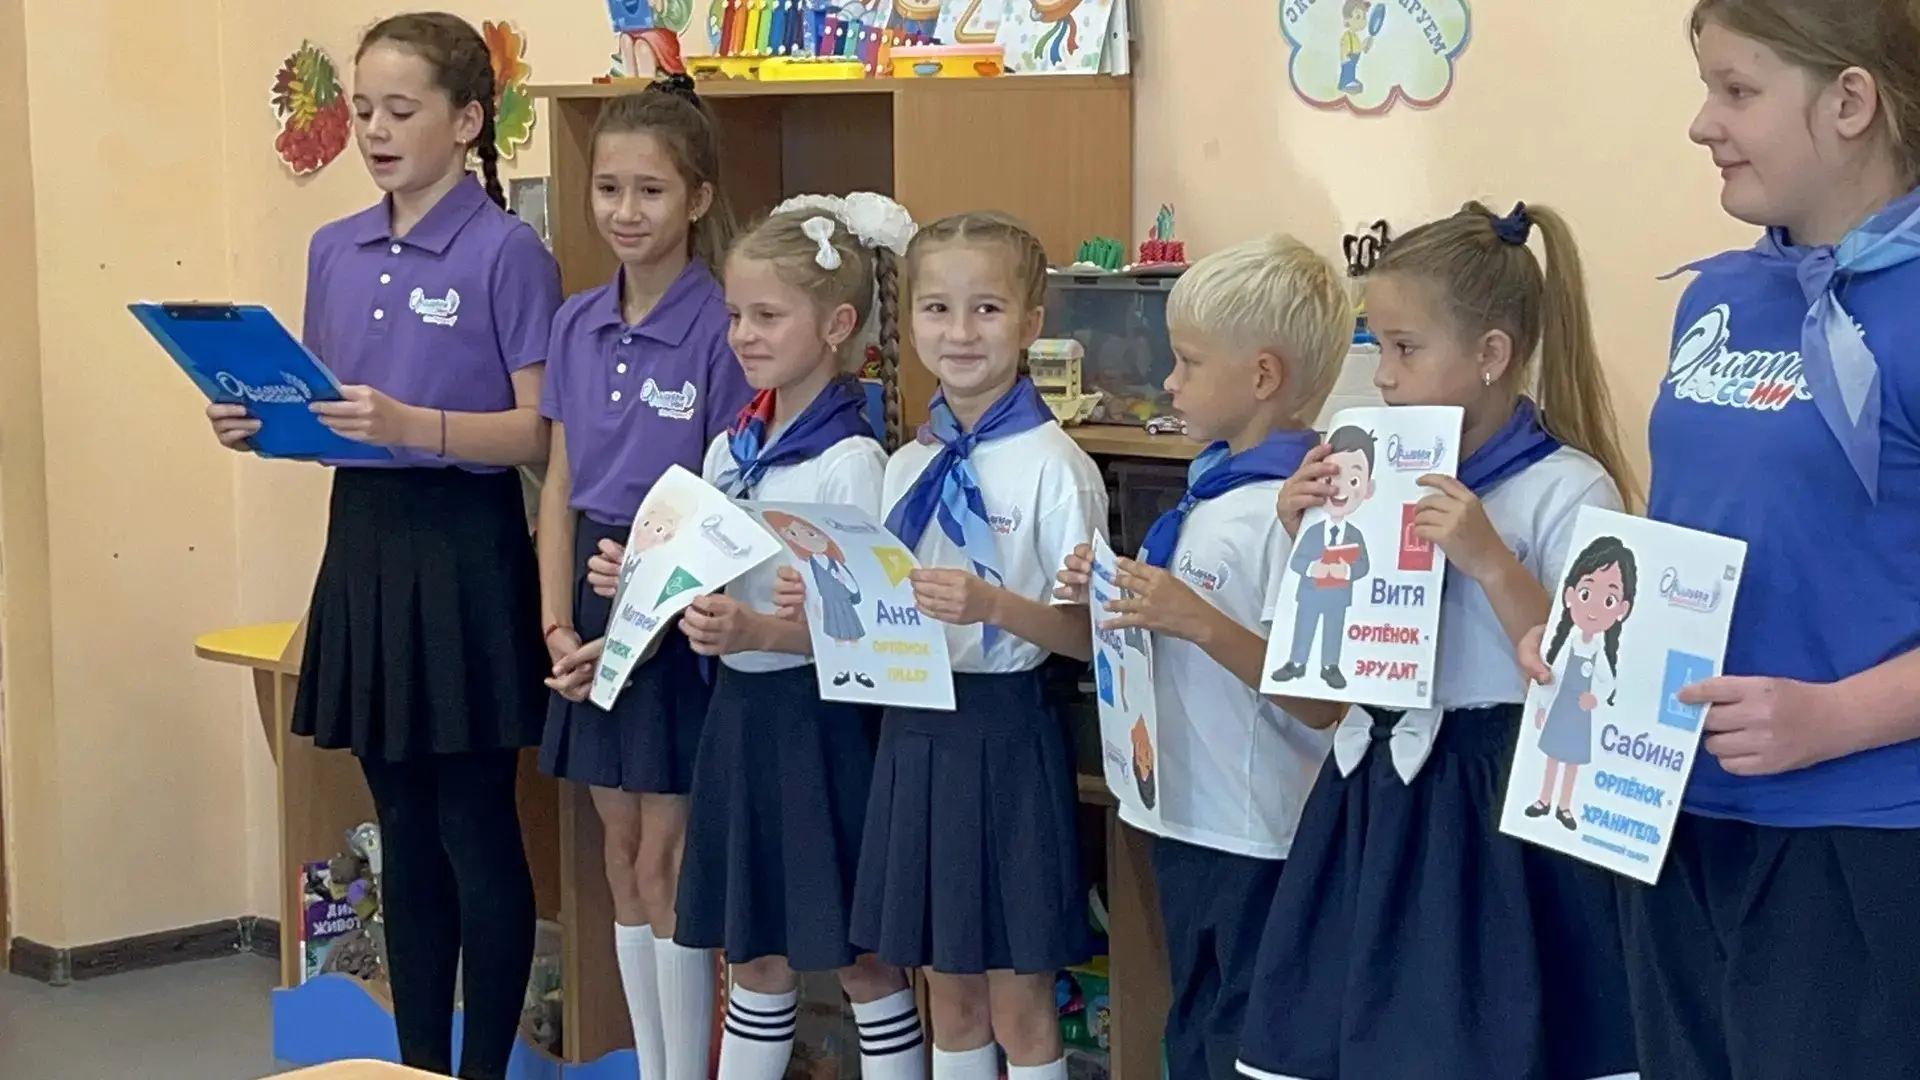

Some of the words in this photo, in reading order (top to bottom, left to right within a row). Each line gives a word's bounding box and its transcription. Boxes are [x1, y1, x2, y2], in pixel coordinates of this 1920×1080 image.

[1370, 577, 1425, 607] Витя
[621, 602, 661, 632] Матвей
[876, 599, 921, 626] Аня
[1347, 623, 1419, 645] ОРЛЁНОК
[1354, 659, 1418, 680] ЭРУДИТ
[1600, 723, 1685, 772] Сабина
[1594, 769, 1666, 808] ОРЛЁНОК
[1580, 803, 1662, 846] ХРАНИТЕЛЬ
